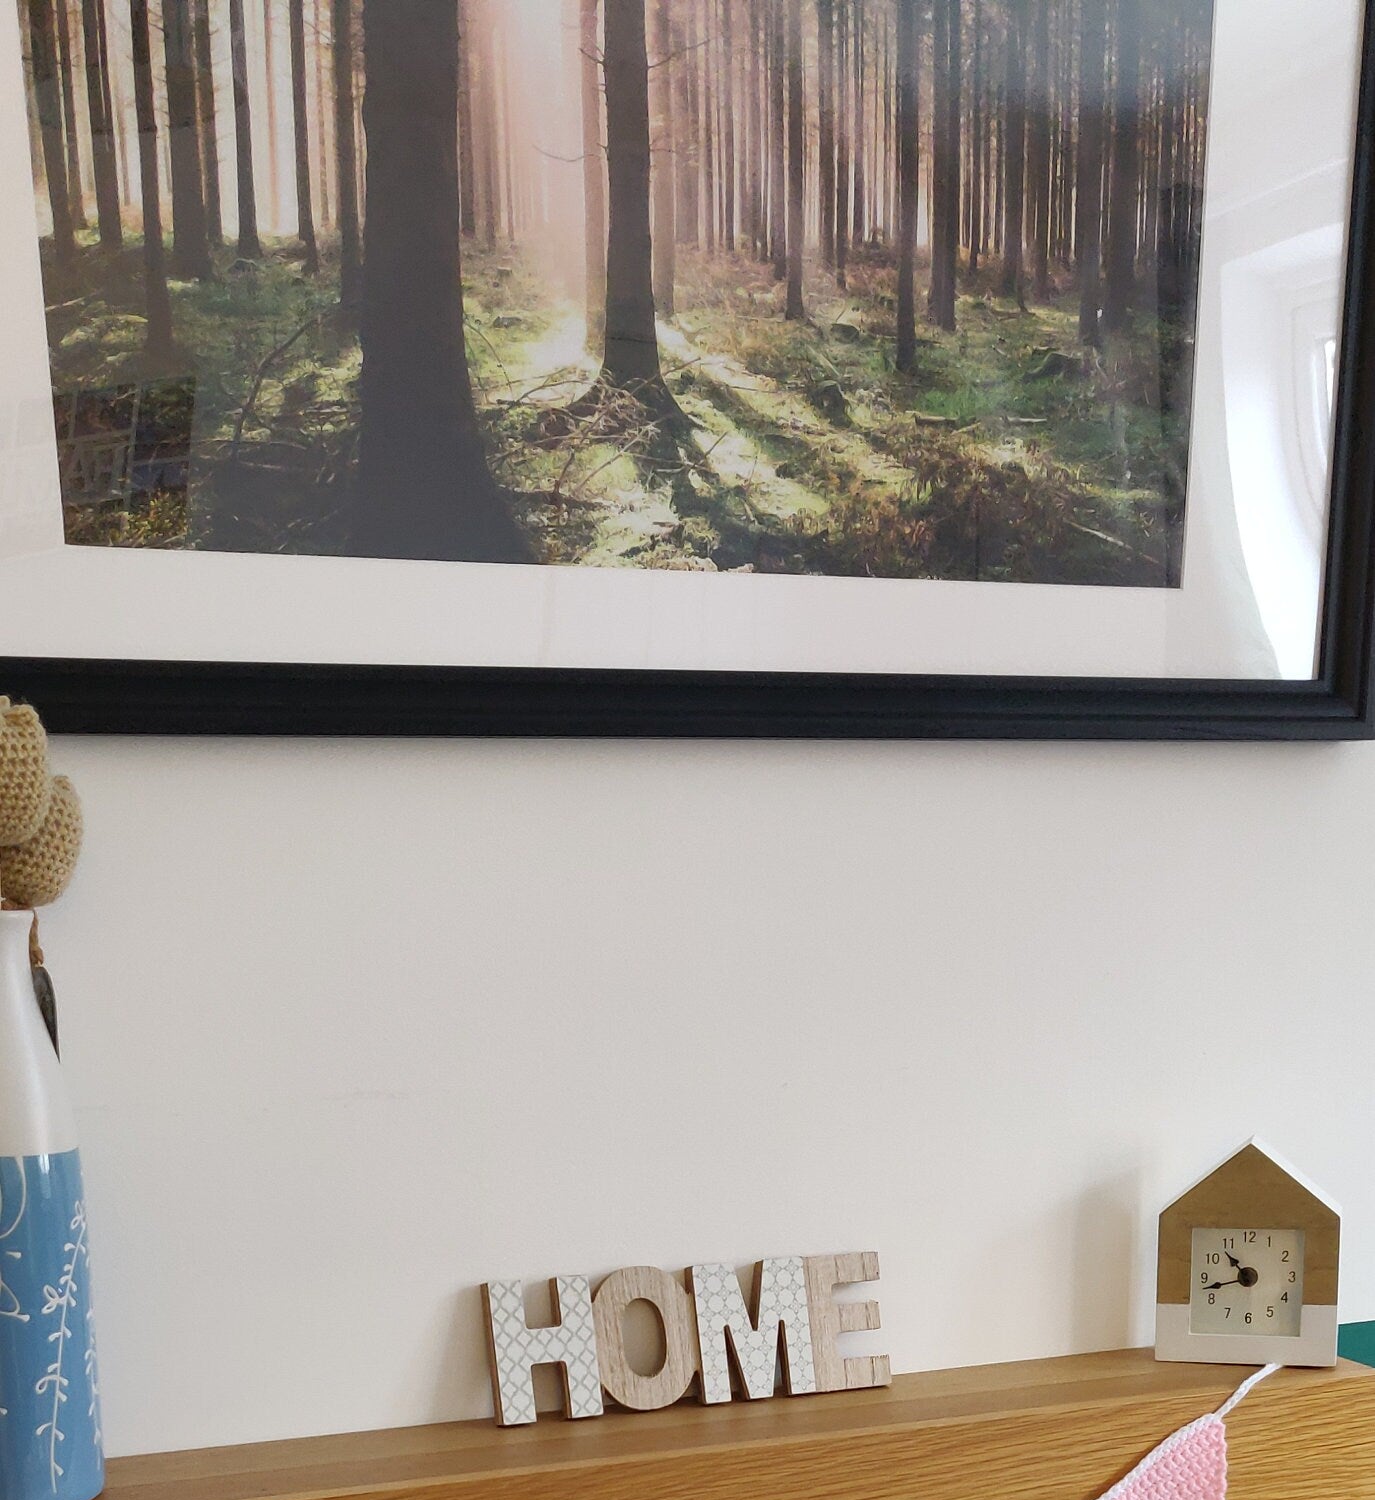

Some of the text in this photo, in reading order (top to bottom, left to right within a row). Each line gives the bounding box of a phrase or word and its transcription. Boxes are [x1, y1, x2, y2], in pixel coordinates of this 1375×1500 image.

[1243, 1231, 1257, 1243] 12
[1267, 1235, 1271, 1248] 1
[1222, 1238, 1234, 1249] 11
[1206, 1252, 1220, 1265] 10
[1281, 1250, 1289, 1263] 2
[1200, 1272, 1208, 1284] 9
[1287, 1271, 1296, 1283] 3
[1207, 1293, 1215, 1305] 8
[1280, 1292, 1288, 1304] 4
[1224, 1307, 1231, 1319] 7
[1244, 1312, 1252, 1324] 6
[1266, 1306, 1274, 1318] 5
[480, 1251, 891, 1426] HOME
